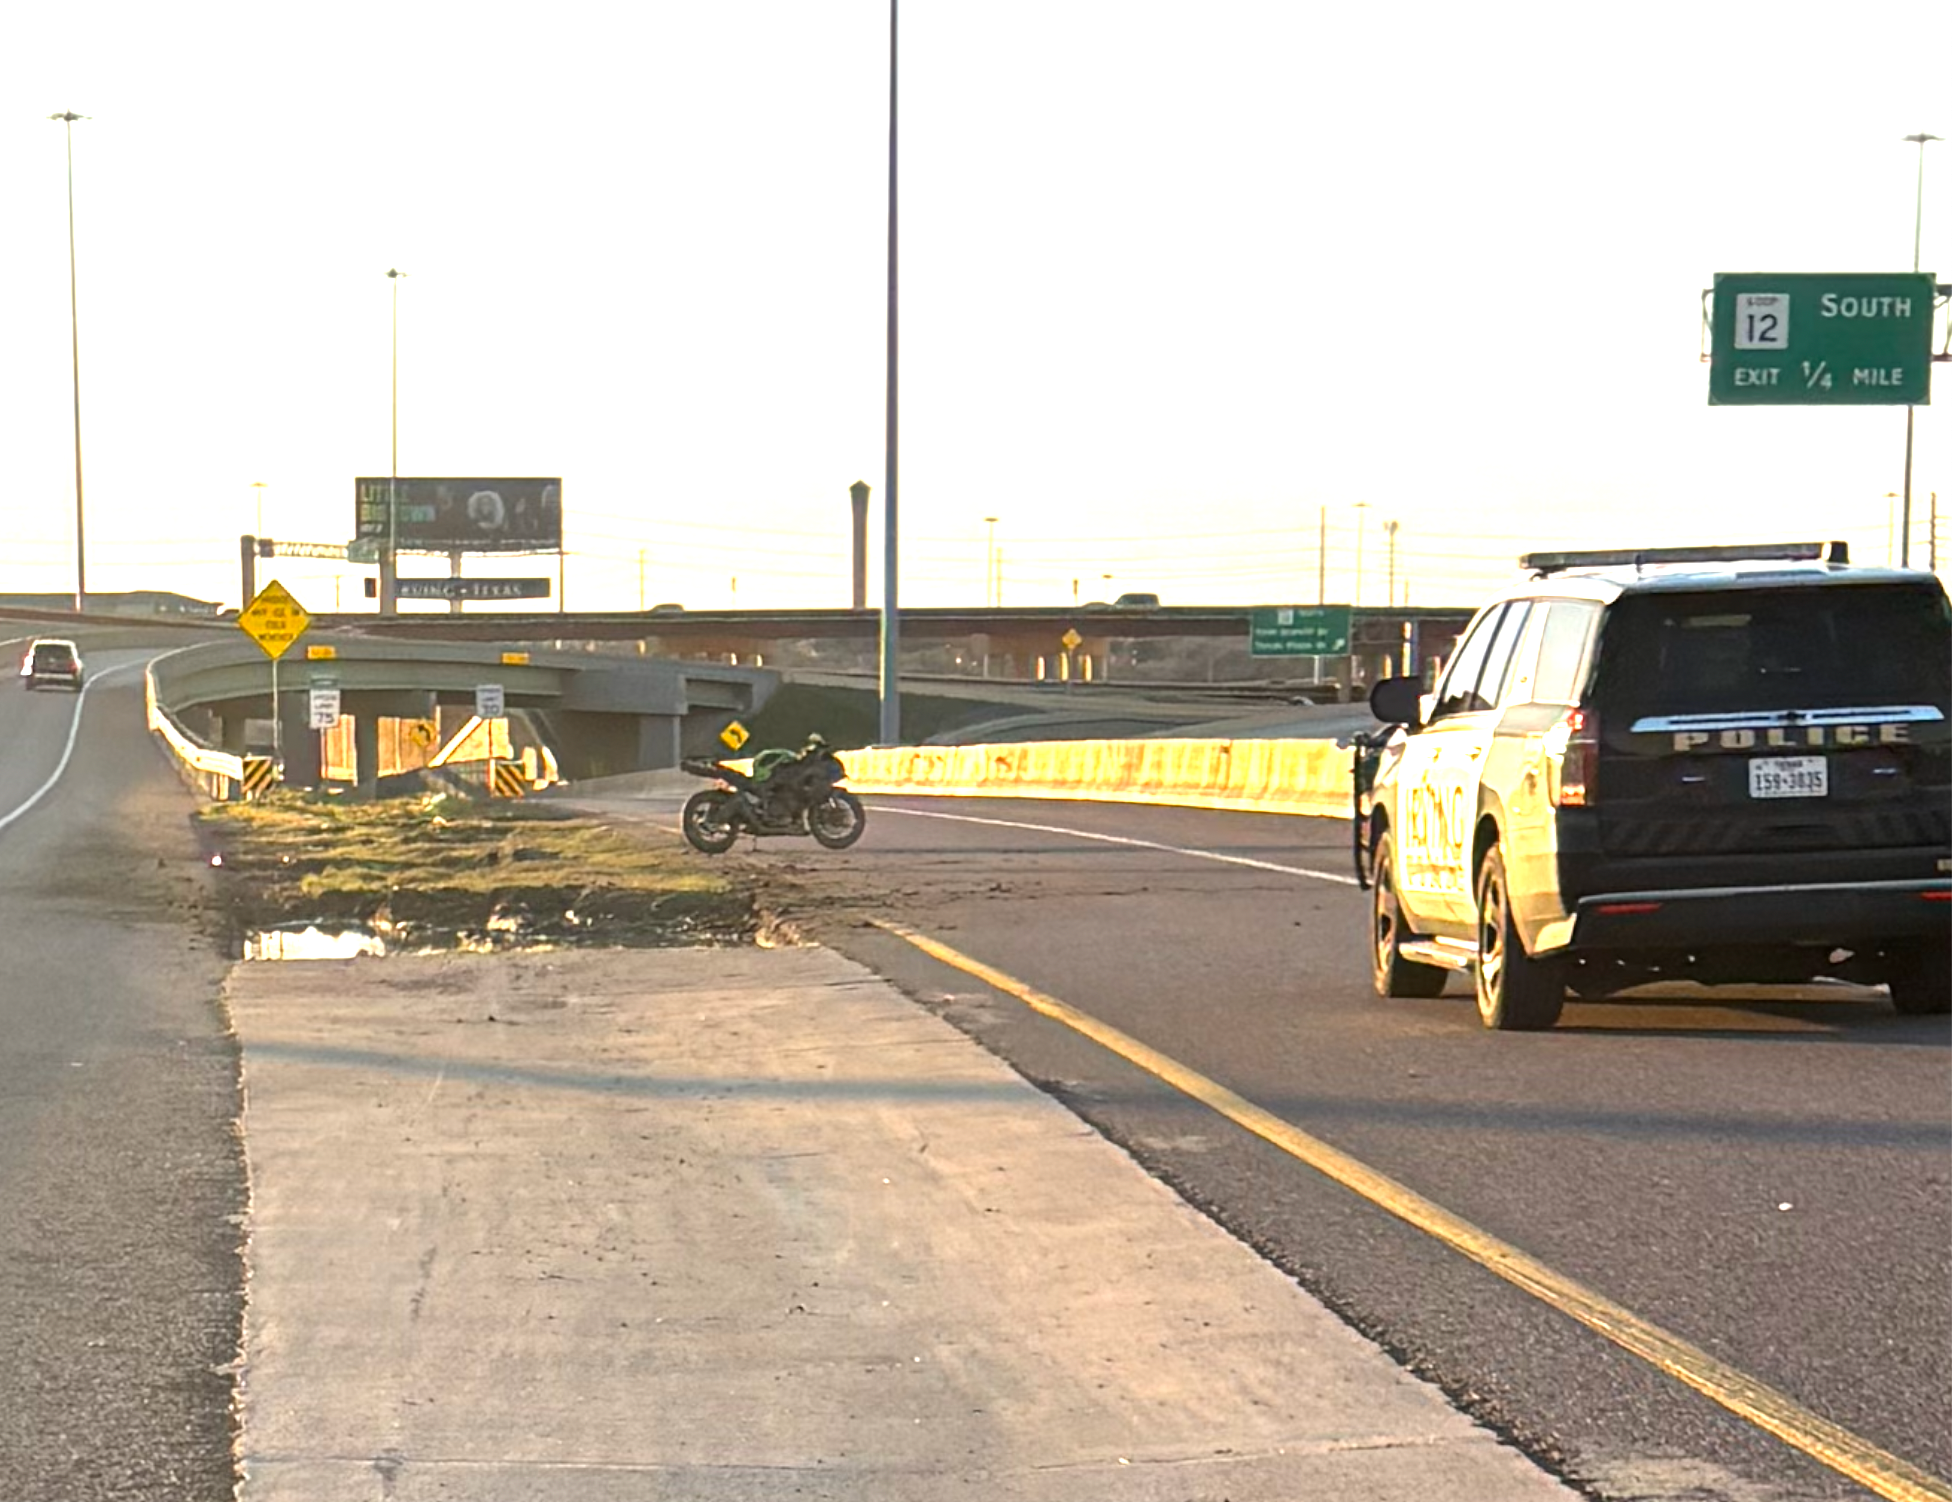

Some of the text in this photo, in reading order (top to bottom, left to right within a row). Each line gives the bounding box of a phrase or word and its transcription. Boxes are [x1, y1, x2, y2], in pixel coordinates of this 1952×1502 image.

[1820, 293, 1912, 318] SOUTH
[1747, 313, 1779, 343] 12
[1734, 368, 1781, 386] EXIT
[1853, 368, 1904, 386] MILE
[1672, 723, 1913, 752] POLICE
